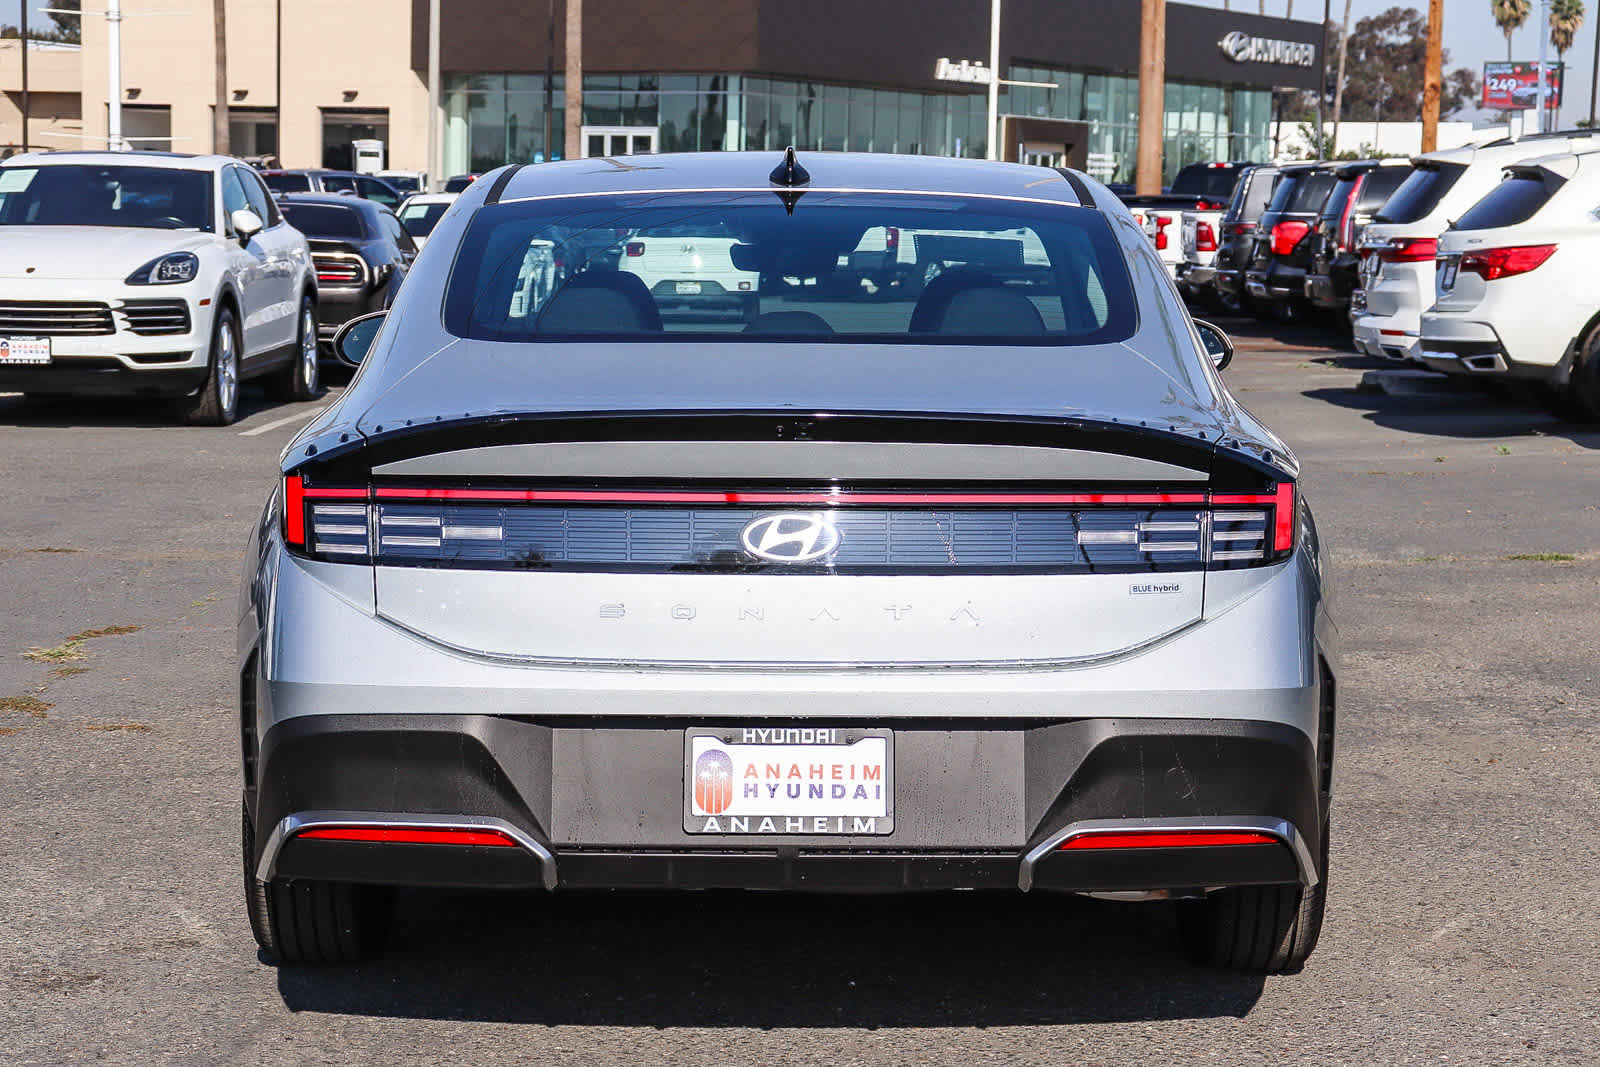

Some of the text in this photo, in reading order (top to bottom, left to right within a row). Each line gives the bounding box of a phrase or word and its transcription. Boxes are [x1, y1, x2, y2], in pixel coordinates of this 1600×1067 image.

[1132, 583, 1180, 593] BLUE hybrid
[598, 601, 982, 622] SONATA
[742, 728, 836, 744] HYUNDAI
[743, 763, 881, 780] ANAHEIM
[743, 783, 881, 799] HYUNDAI
[702, 816, 877, 833] ANAHEIM
